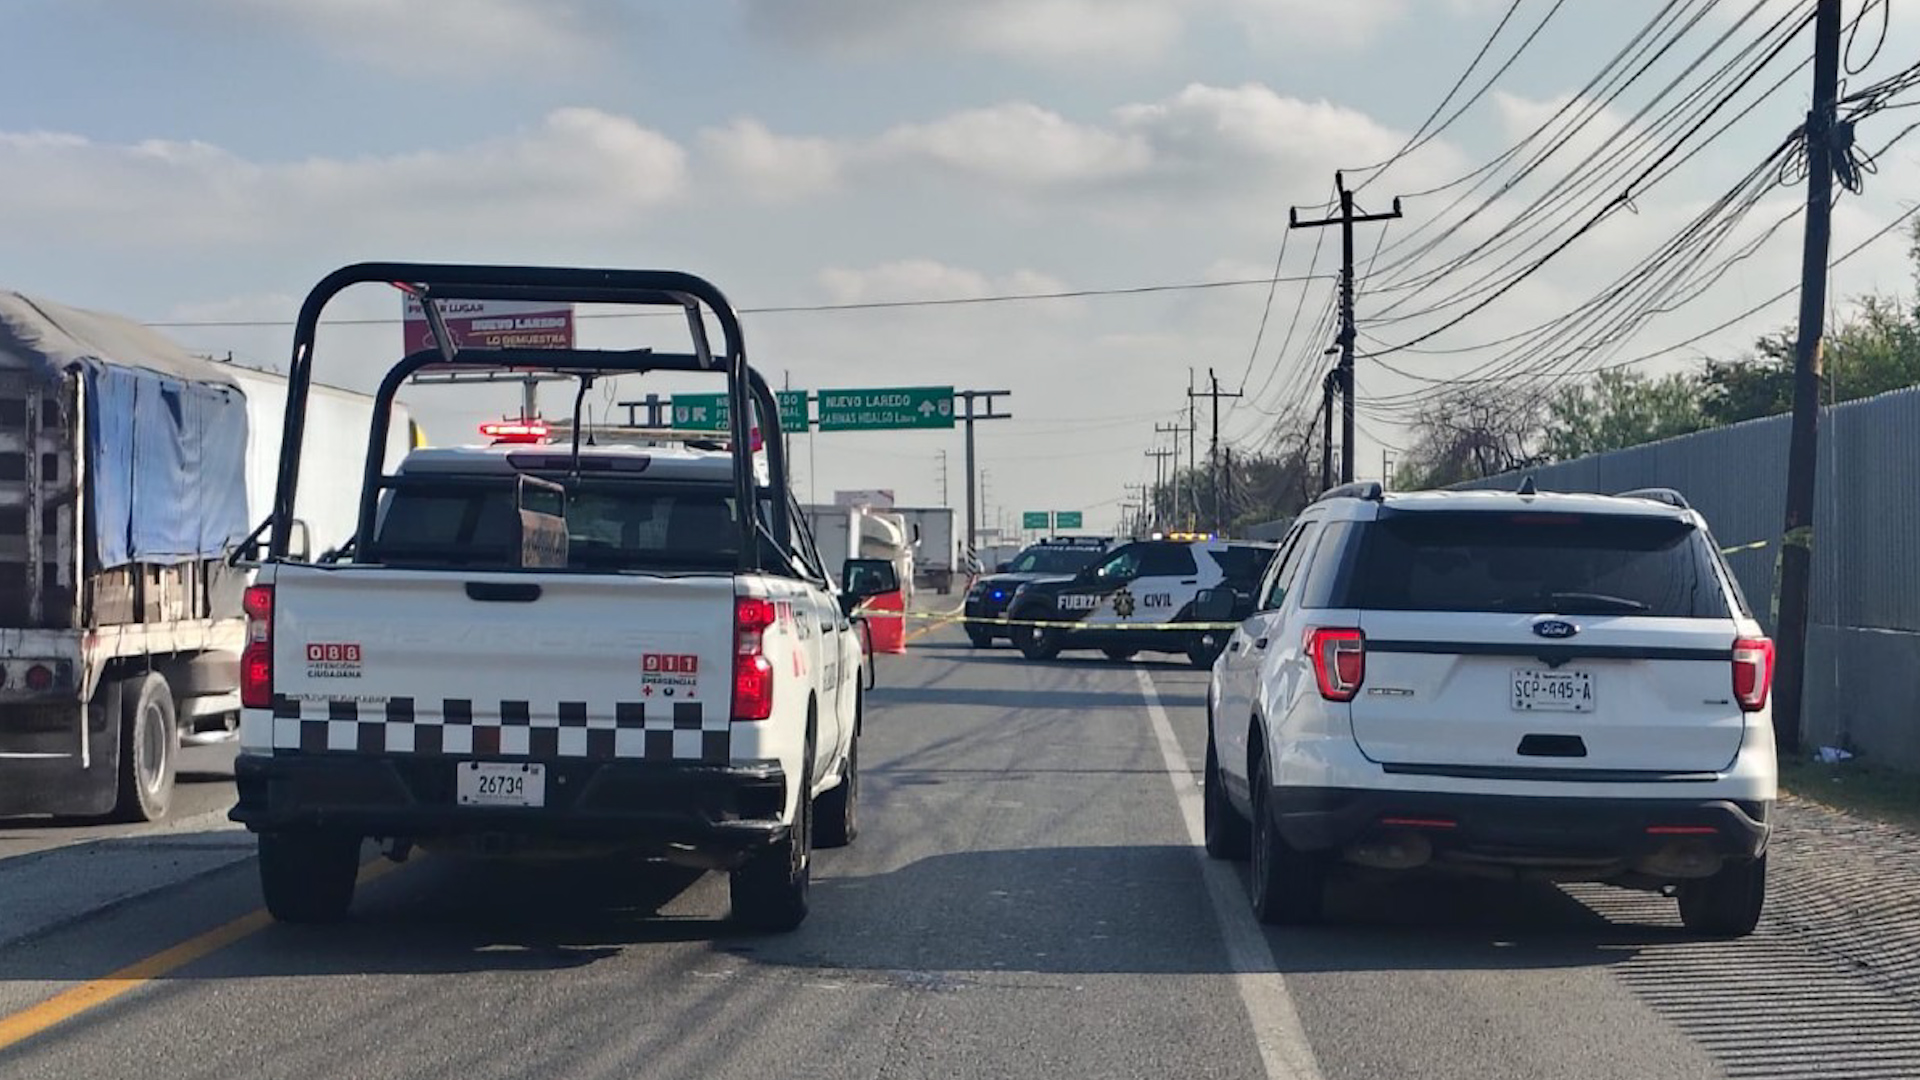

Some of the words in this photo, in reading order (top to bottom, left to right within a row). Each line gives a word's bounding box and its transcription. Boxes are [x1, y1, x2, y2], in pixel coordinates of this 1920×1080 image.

[472, 319, 513, 331] NUEVO
[515, 317, 566, 329] LAREDO
[486, 336, 501, 345] LO
[502, 334, 567, 345] DEMUESTRA
[826, 396, 861, 408] NUEVO
[866, 394, 911, 407] LAREDO
[820, 412, 856, 425] SABINAS
[858, 411, 893, 423] HIDALGO
[1058, 594, 1102, 610] FUERZA
[1144, 593, 1172, 607] CIVIL
[1541, 623, 1569, 635] Ford
[310, 646, 357, 660] 088
[646, 656, 692, 670] 911
[307, 670, 361, 678] CIUDADANA
[1515, 681, 1591, 699] SCP-445-A
[480, 776, 523, 794] 26734
